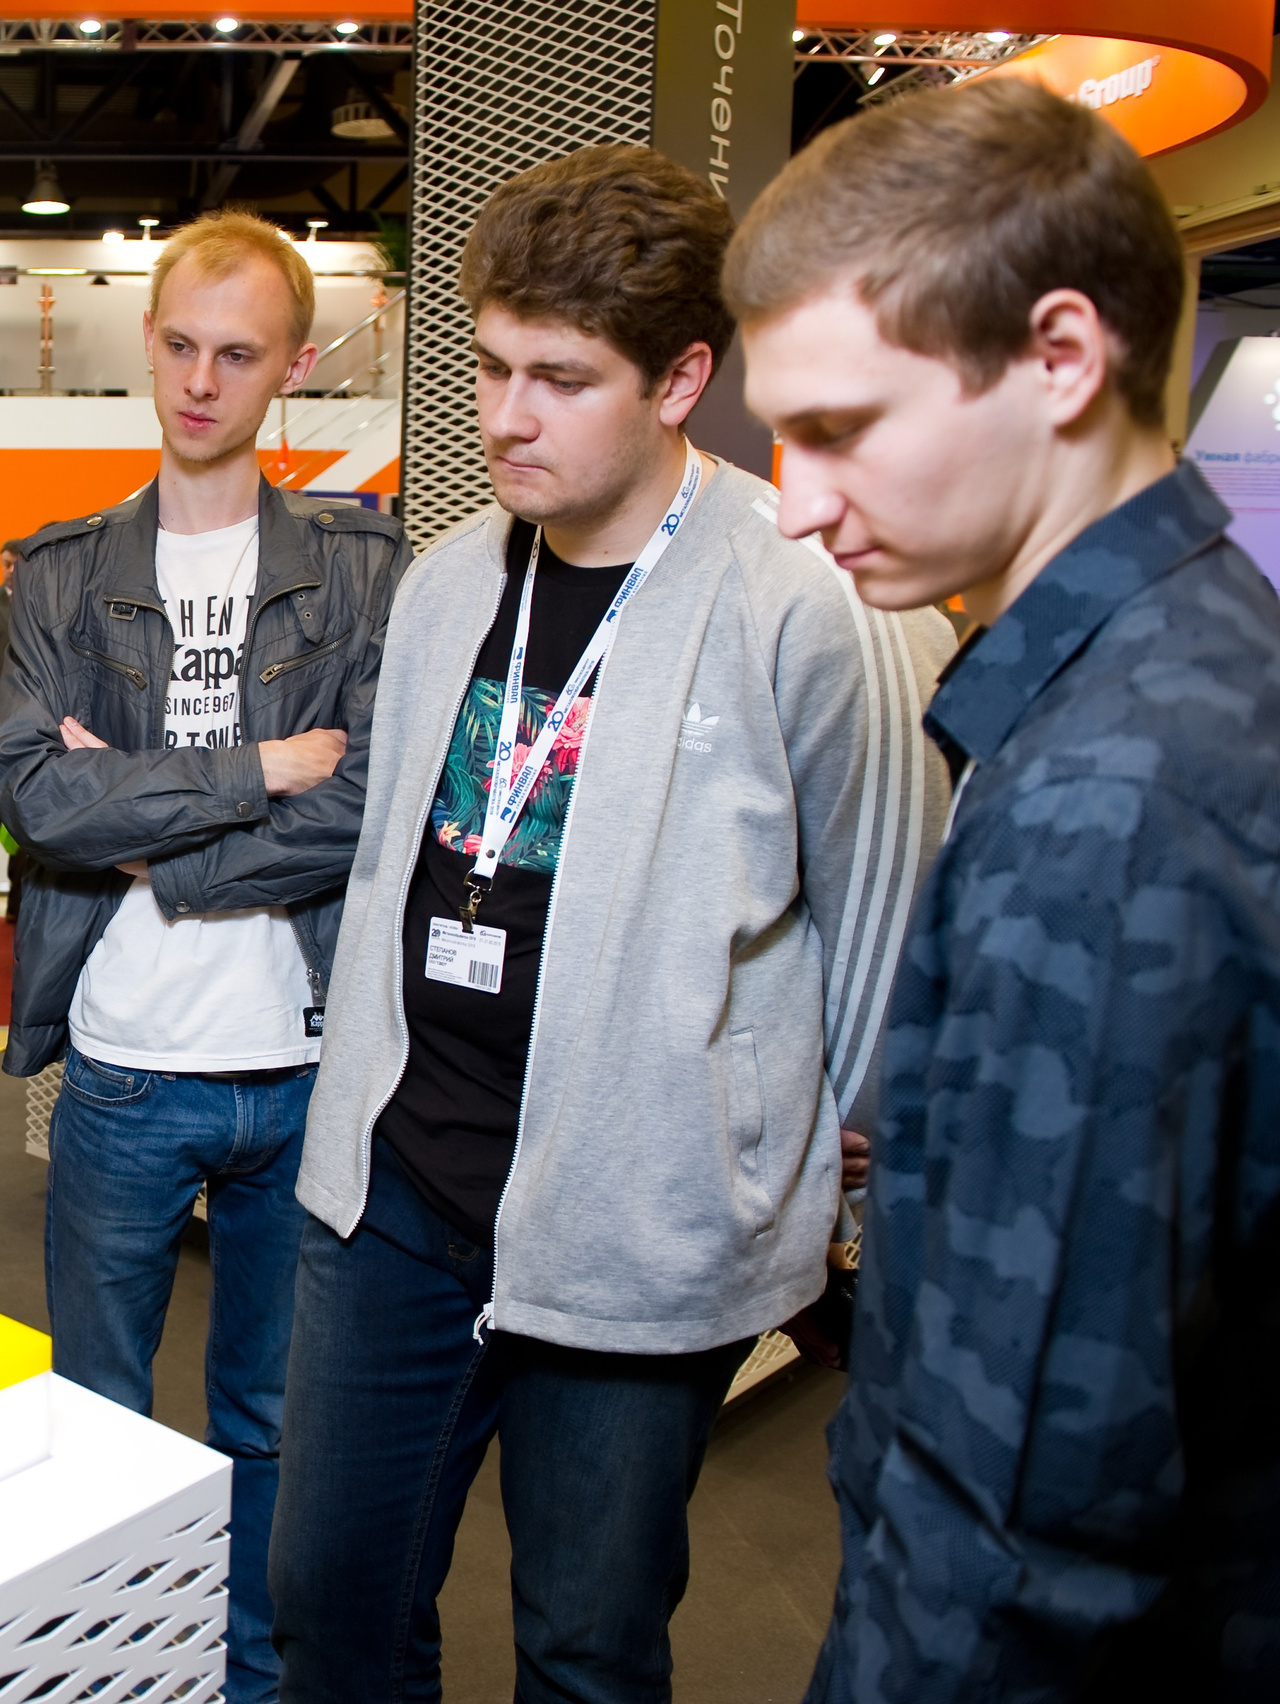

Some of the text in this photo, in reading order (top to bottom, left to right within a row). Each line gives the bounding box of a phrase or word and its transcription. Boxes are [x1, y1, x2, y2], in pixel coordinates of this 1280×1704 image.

[1078, 57, 1153, 110] Group
[661, 513, 680, 536] 20
[614, 567, 644, 608] ФИНВАЛ
[510, 661, 522, 704] ФИНВАЛ
[547, 710, 564, 732] 20
[498, 741, 512, 761] 20
[507, 765, 534, 806] ФИНВАЛ
